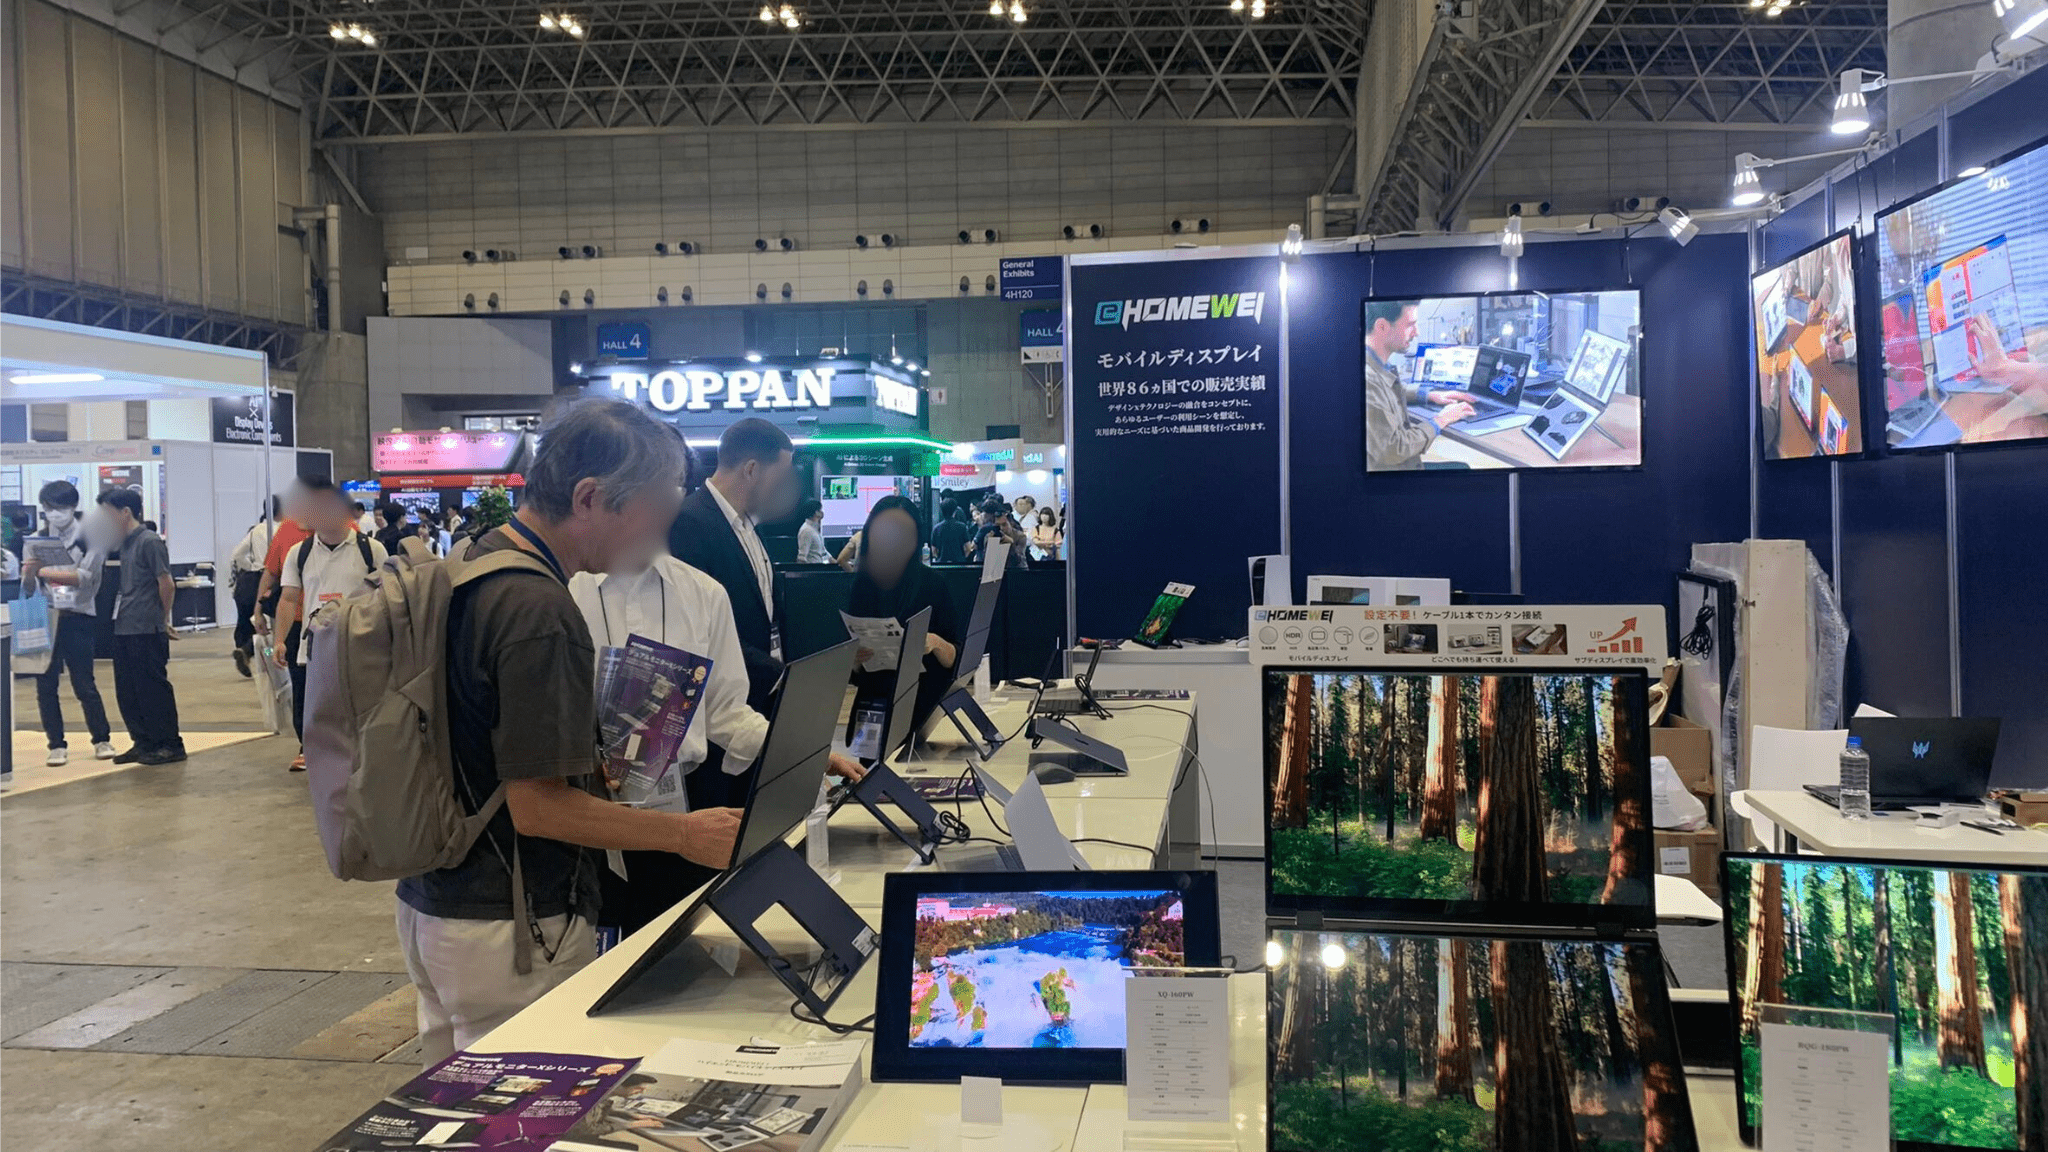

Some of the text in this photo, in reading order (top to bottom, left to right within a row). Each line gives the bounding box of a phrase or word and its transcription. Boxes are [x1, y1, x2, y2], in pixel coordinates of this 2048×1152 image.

[1002, 259, 1034, 269] General
[1003, 269, 1035, 278] Exhibits
[1005, 289, 1033, 299] 4H120
[1027, 328, 1053, 337] HALL
[603, 333, 642, 350] HALL 4
[1097, 344, 1262, 369] モバイルディスプレイ
[611, 367, 836, 412] TOPPAN
[234, 416, 254, 430] Display
[1589, 631, 1603, 640] UP
[1289, 655, 1349, 663] モバイルディスプレイ
